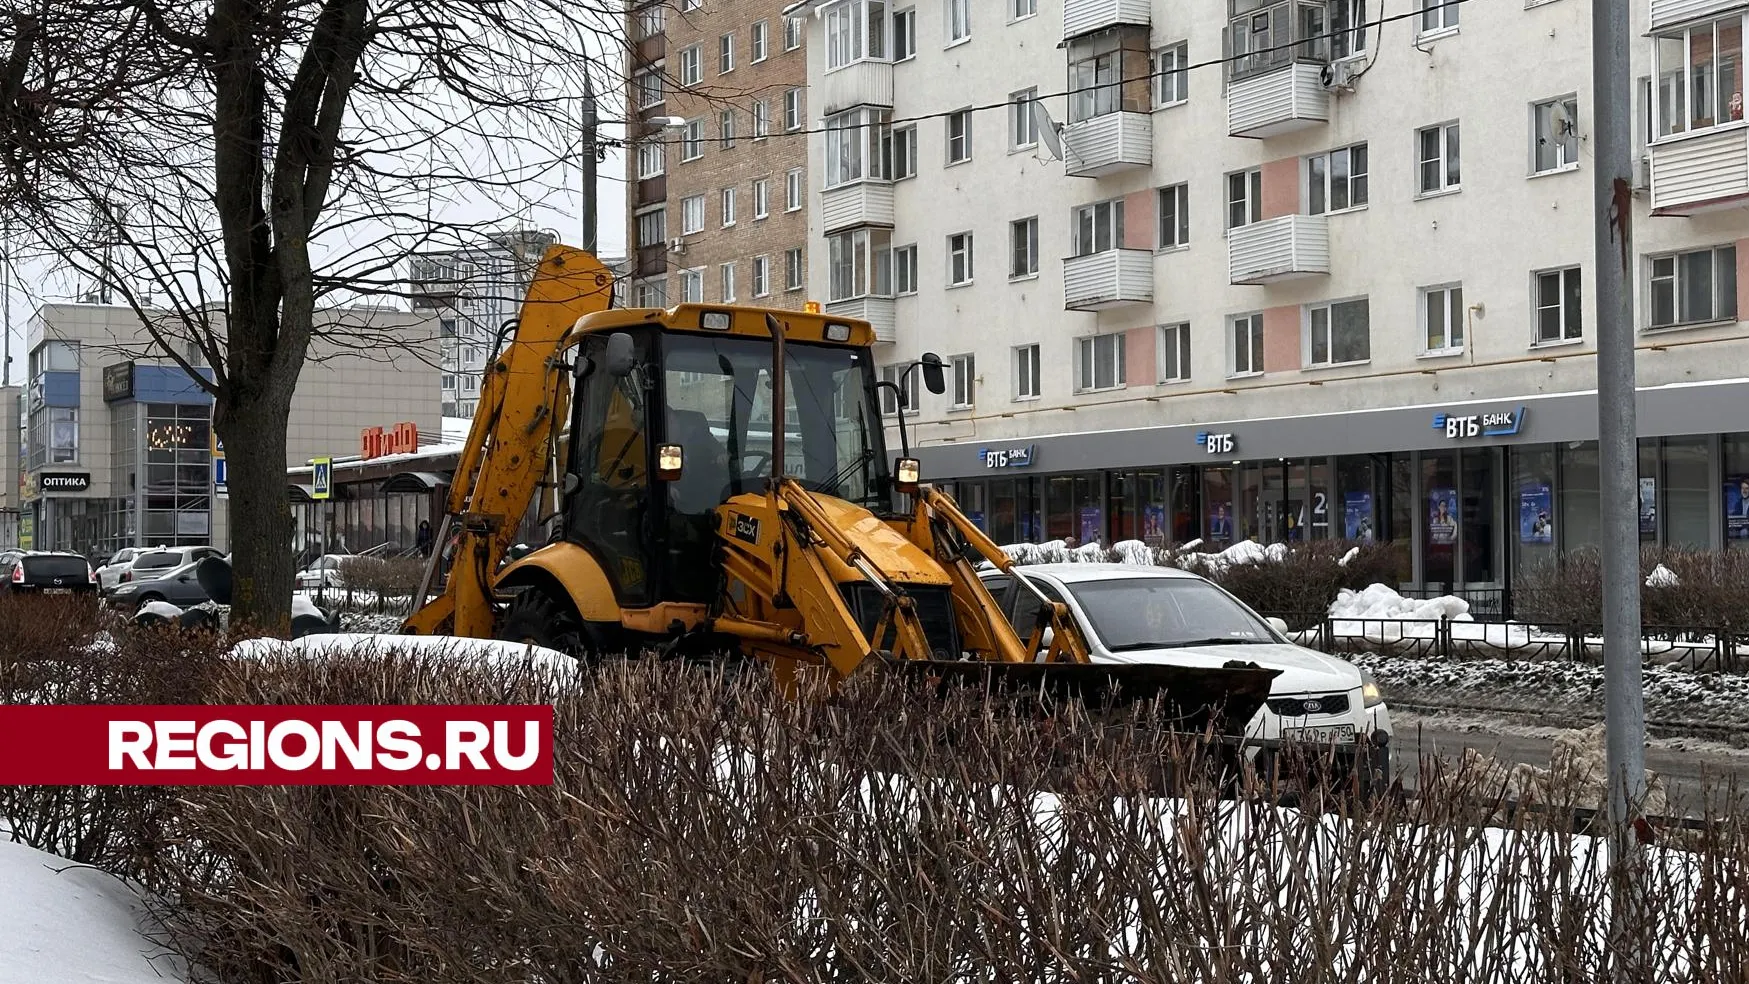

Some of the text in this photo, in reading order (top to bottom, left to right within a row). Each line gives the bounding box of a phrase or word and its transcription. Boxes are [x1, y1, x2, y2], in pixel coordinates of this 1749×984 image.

[1446, 412, 1512, 438] ВТБ БАНК
[1207, 433, 1234, 454] ВТБ
[986, 448, 1027, 468] ВТБ БАНК
[43, 477, 86, 486] ОПТИКА
[737, 520, 756, 537] 3CX
